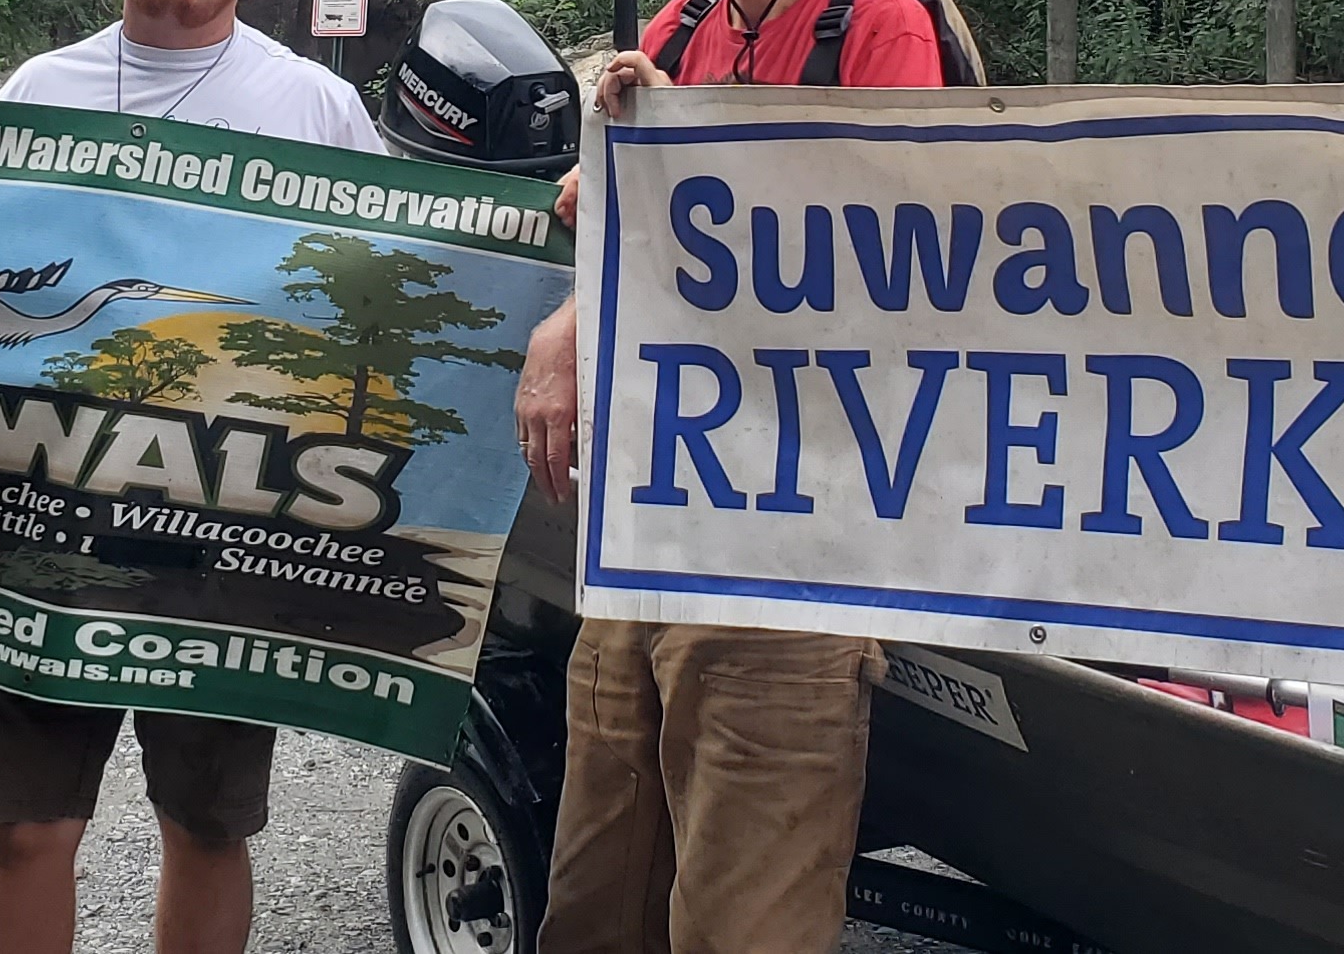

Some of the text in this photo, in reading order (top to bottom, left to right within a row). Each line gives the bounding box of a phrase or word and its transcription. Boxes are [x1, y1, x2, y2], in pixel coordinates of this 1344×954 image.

[398, 62, 478, 130] MERCURY
[240, 158, 551, 247] Conservation
[111, 502, 386, 566] Willacoochee
[214, 547, 428, 604] Suwannee
[74, 621, 416, 706] Coalition
[853, 885, 884, 905] LEE
